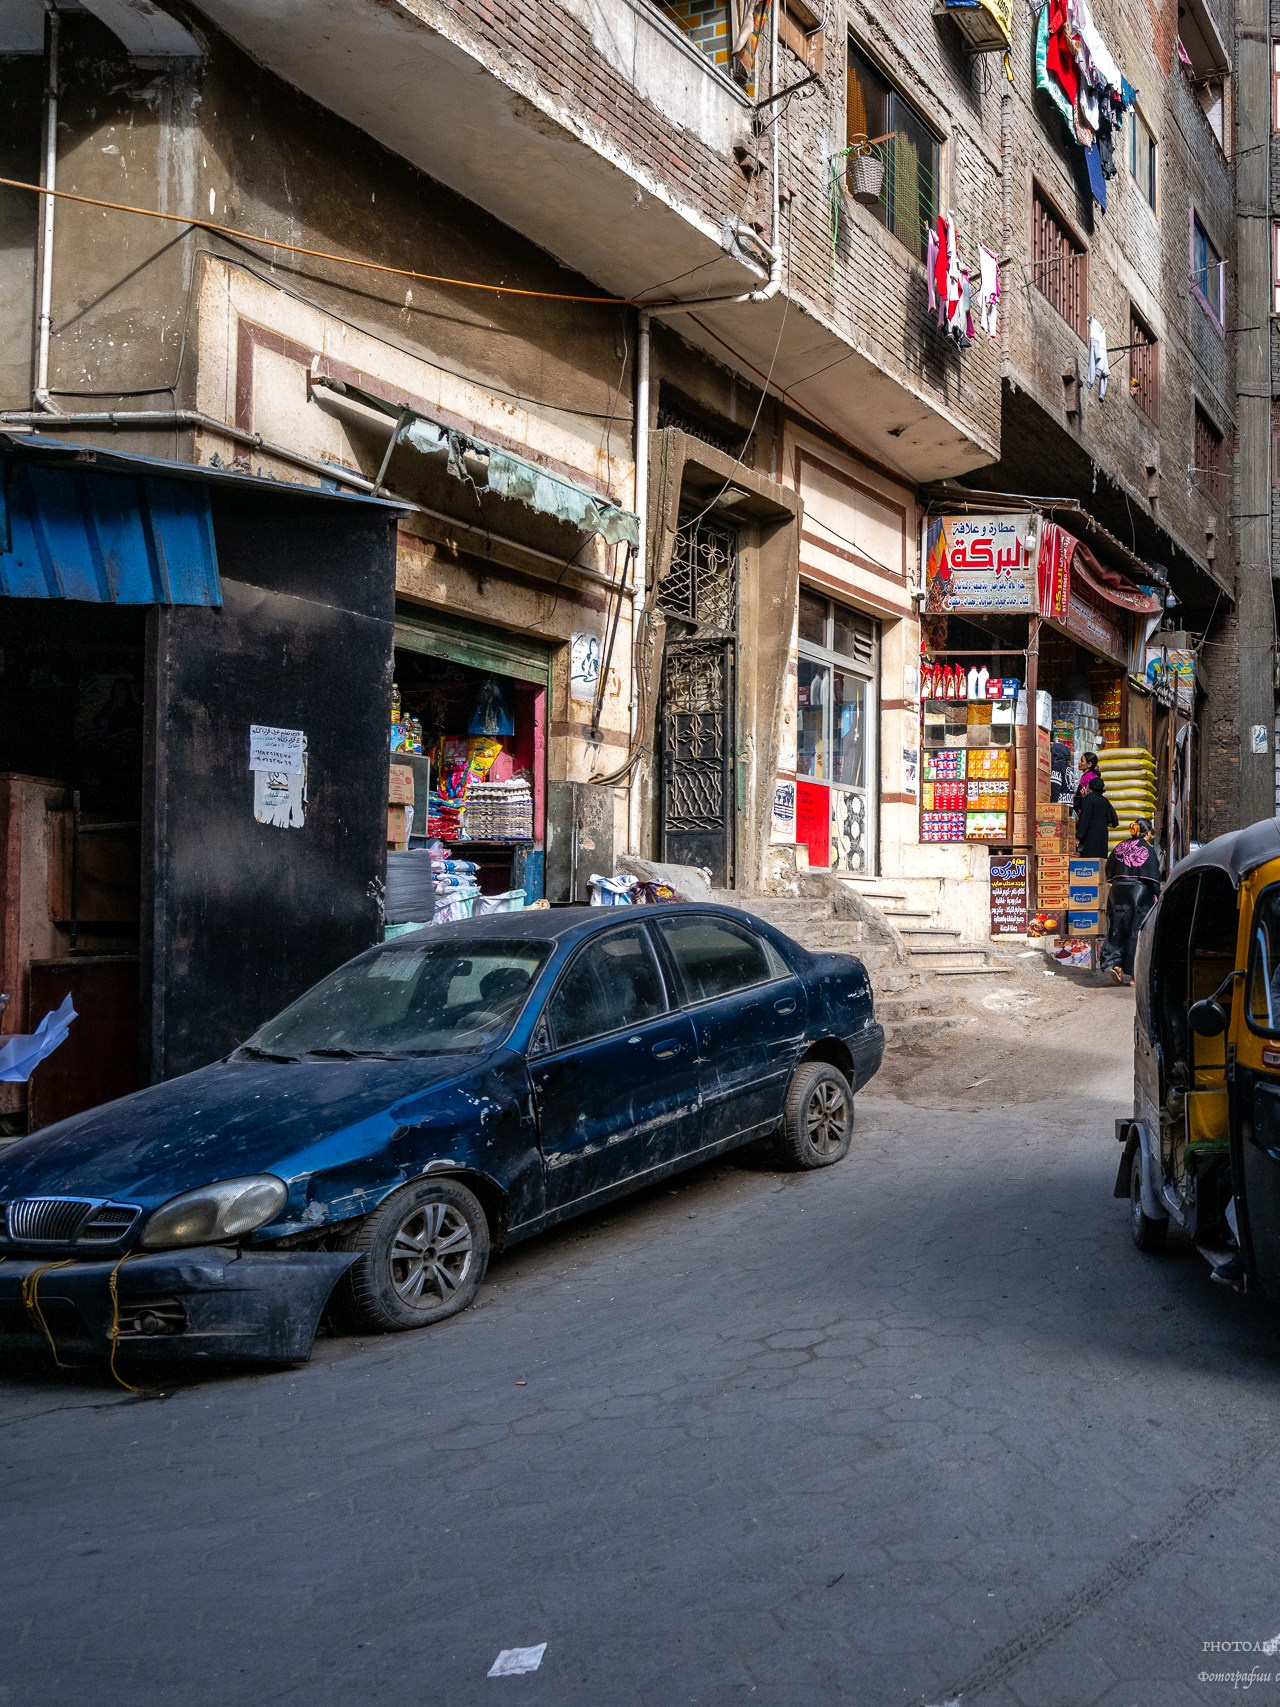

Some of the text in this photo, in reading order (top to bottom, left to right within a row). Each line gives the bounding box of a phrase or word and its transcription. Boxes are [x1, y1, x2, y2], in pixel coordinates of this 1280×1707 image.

[980, 527, 986, 536] و
[989, 522, 1016, 536] عطارة
[950, 537, 1031, 577] البركة
